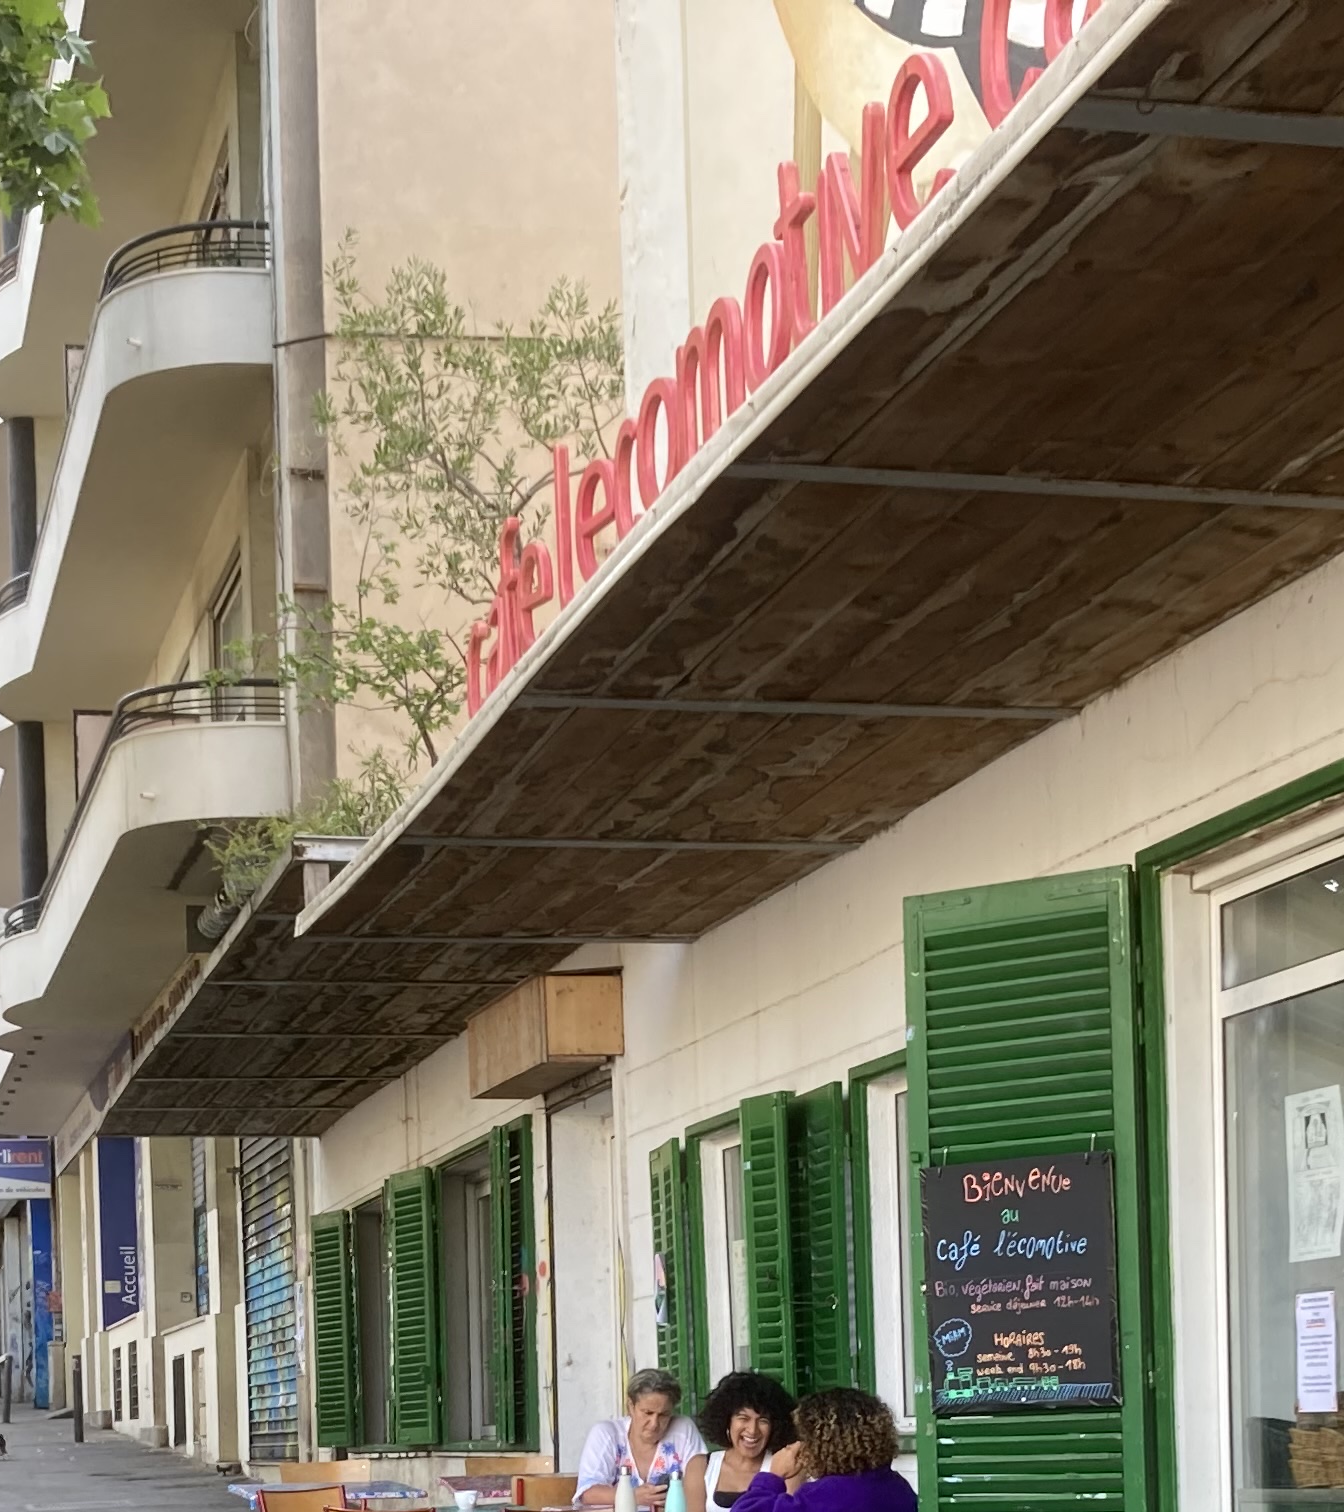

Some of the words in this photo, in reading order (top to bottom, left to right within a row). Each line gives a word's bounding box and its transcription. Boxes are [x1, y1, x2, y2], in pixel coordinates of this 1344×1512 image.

[1001, 1208, 1020, 1224] au
[937, 1230, 981, 1271] Café
[119, 1246, 138, 1306] Accueil
[1025, 1275, 1045, 1299] fait
